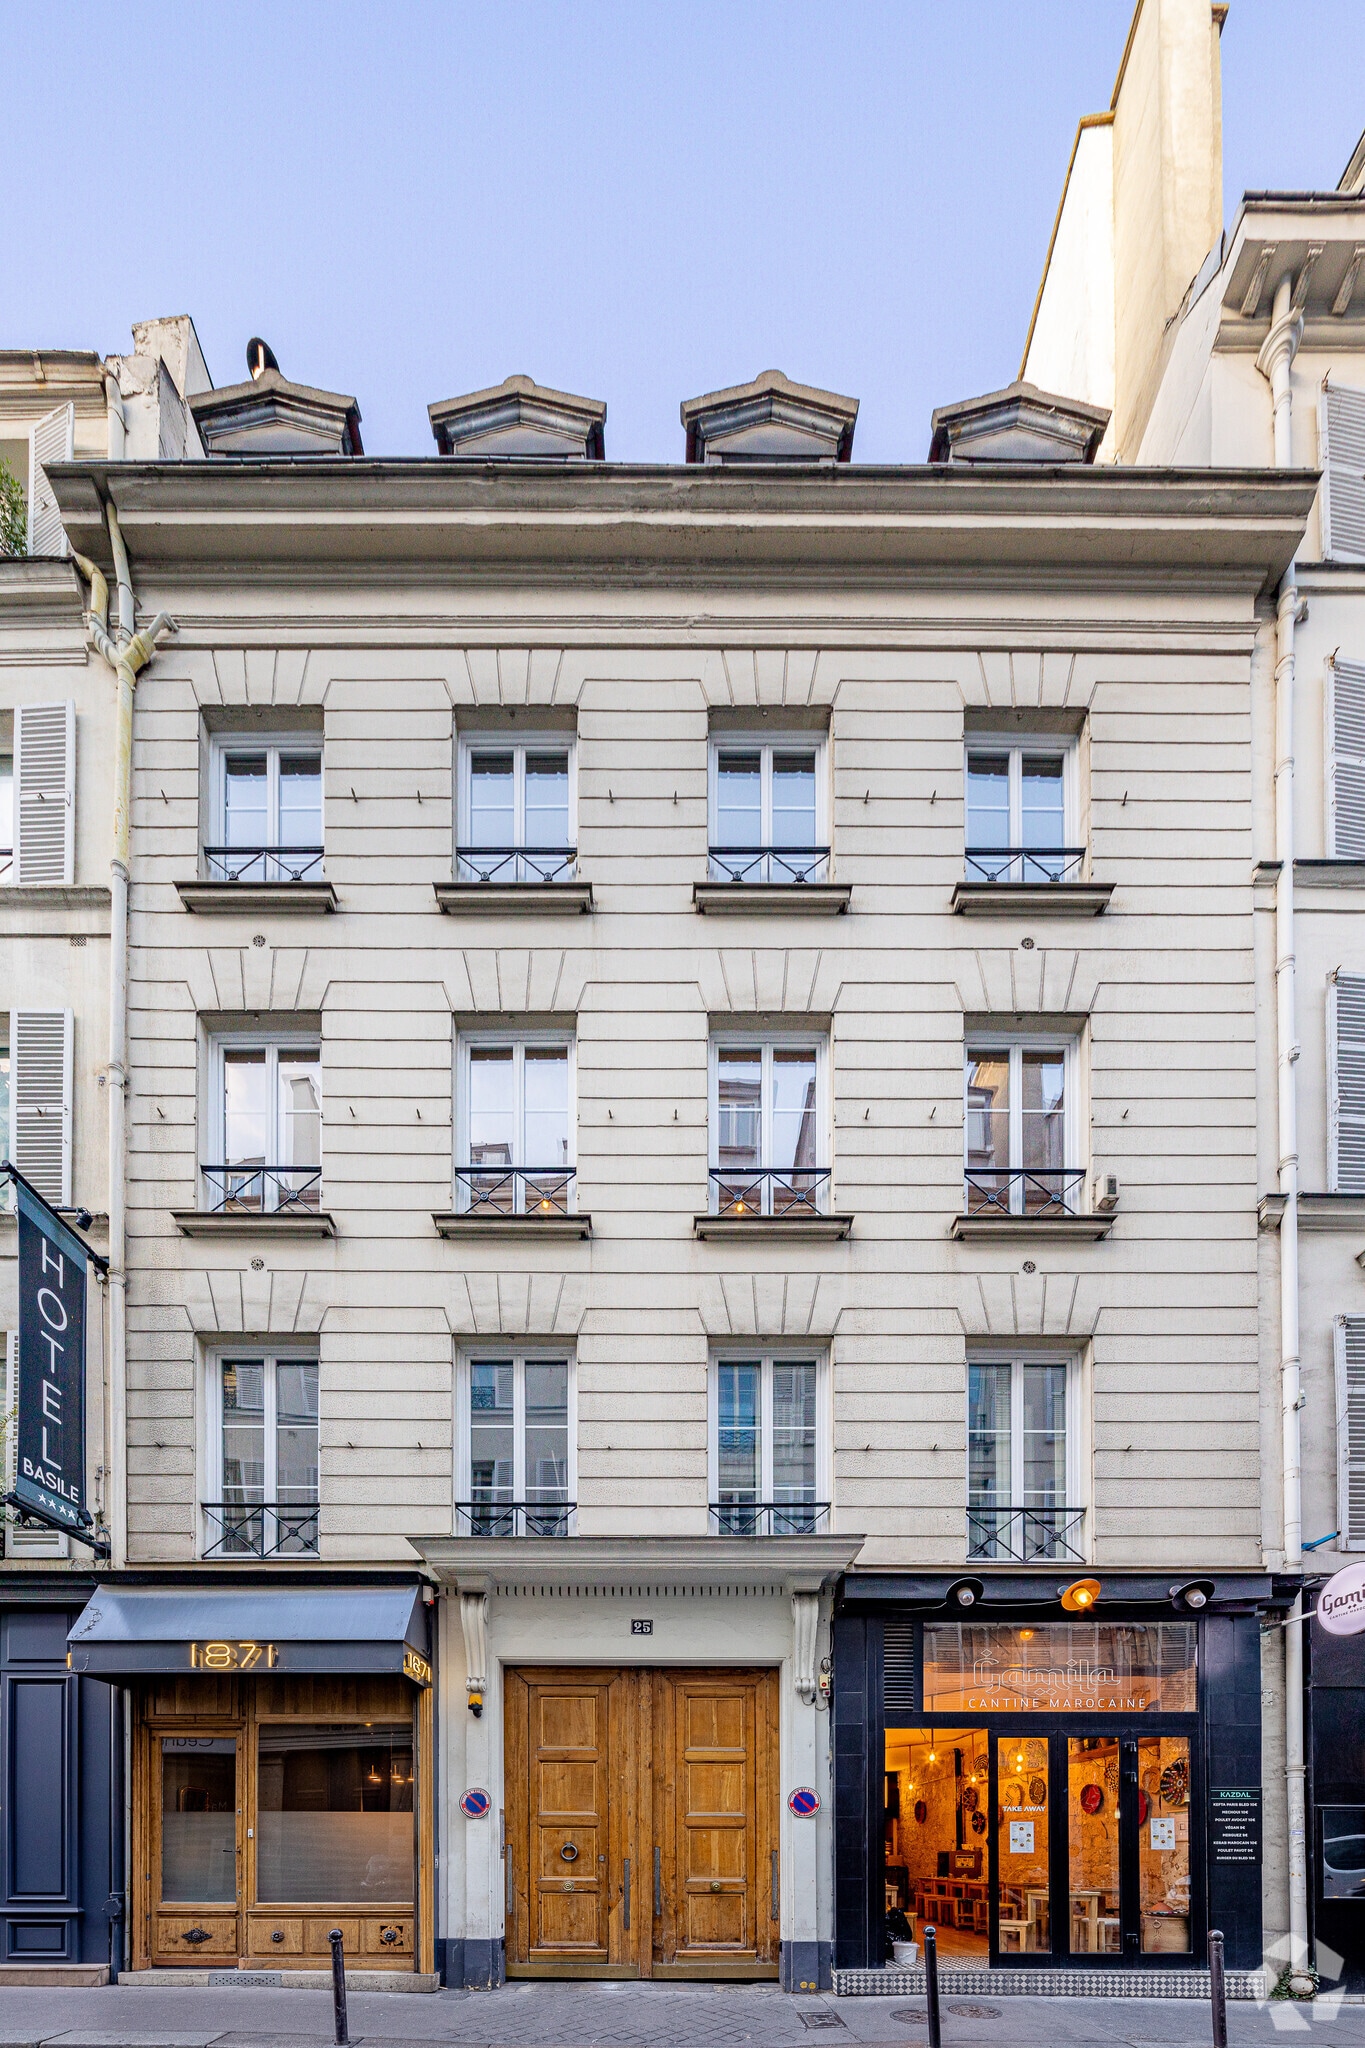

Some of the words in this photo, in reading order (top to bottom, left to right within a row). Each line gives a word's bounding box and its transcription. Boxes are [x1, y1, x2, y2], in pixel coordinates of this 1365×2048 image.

[37, 1237, 68, 1471] HOTEL
[23, 1457, 79, 1504] BASILE
[633, 1621, 651, 1633] 25
[191, 1643, 274, 1668] 1871
[407, 1651, 431, 1682] 1871
[973, 1649, 1121, 1695] Gamila
[968, 1698, 1040, 1709] CANTINE
[1049, 1698, 1147, 1709] MAROCAINE
